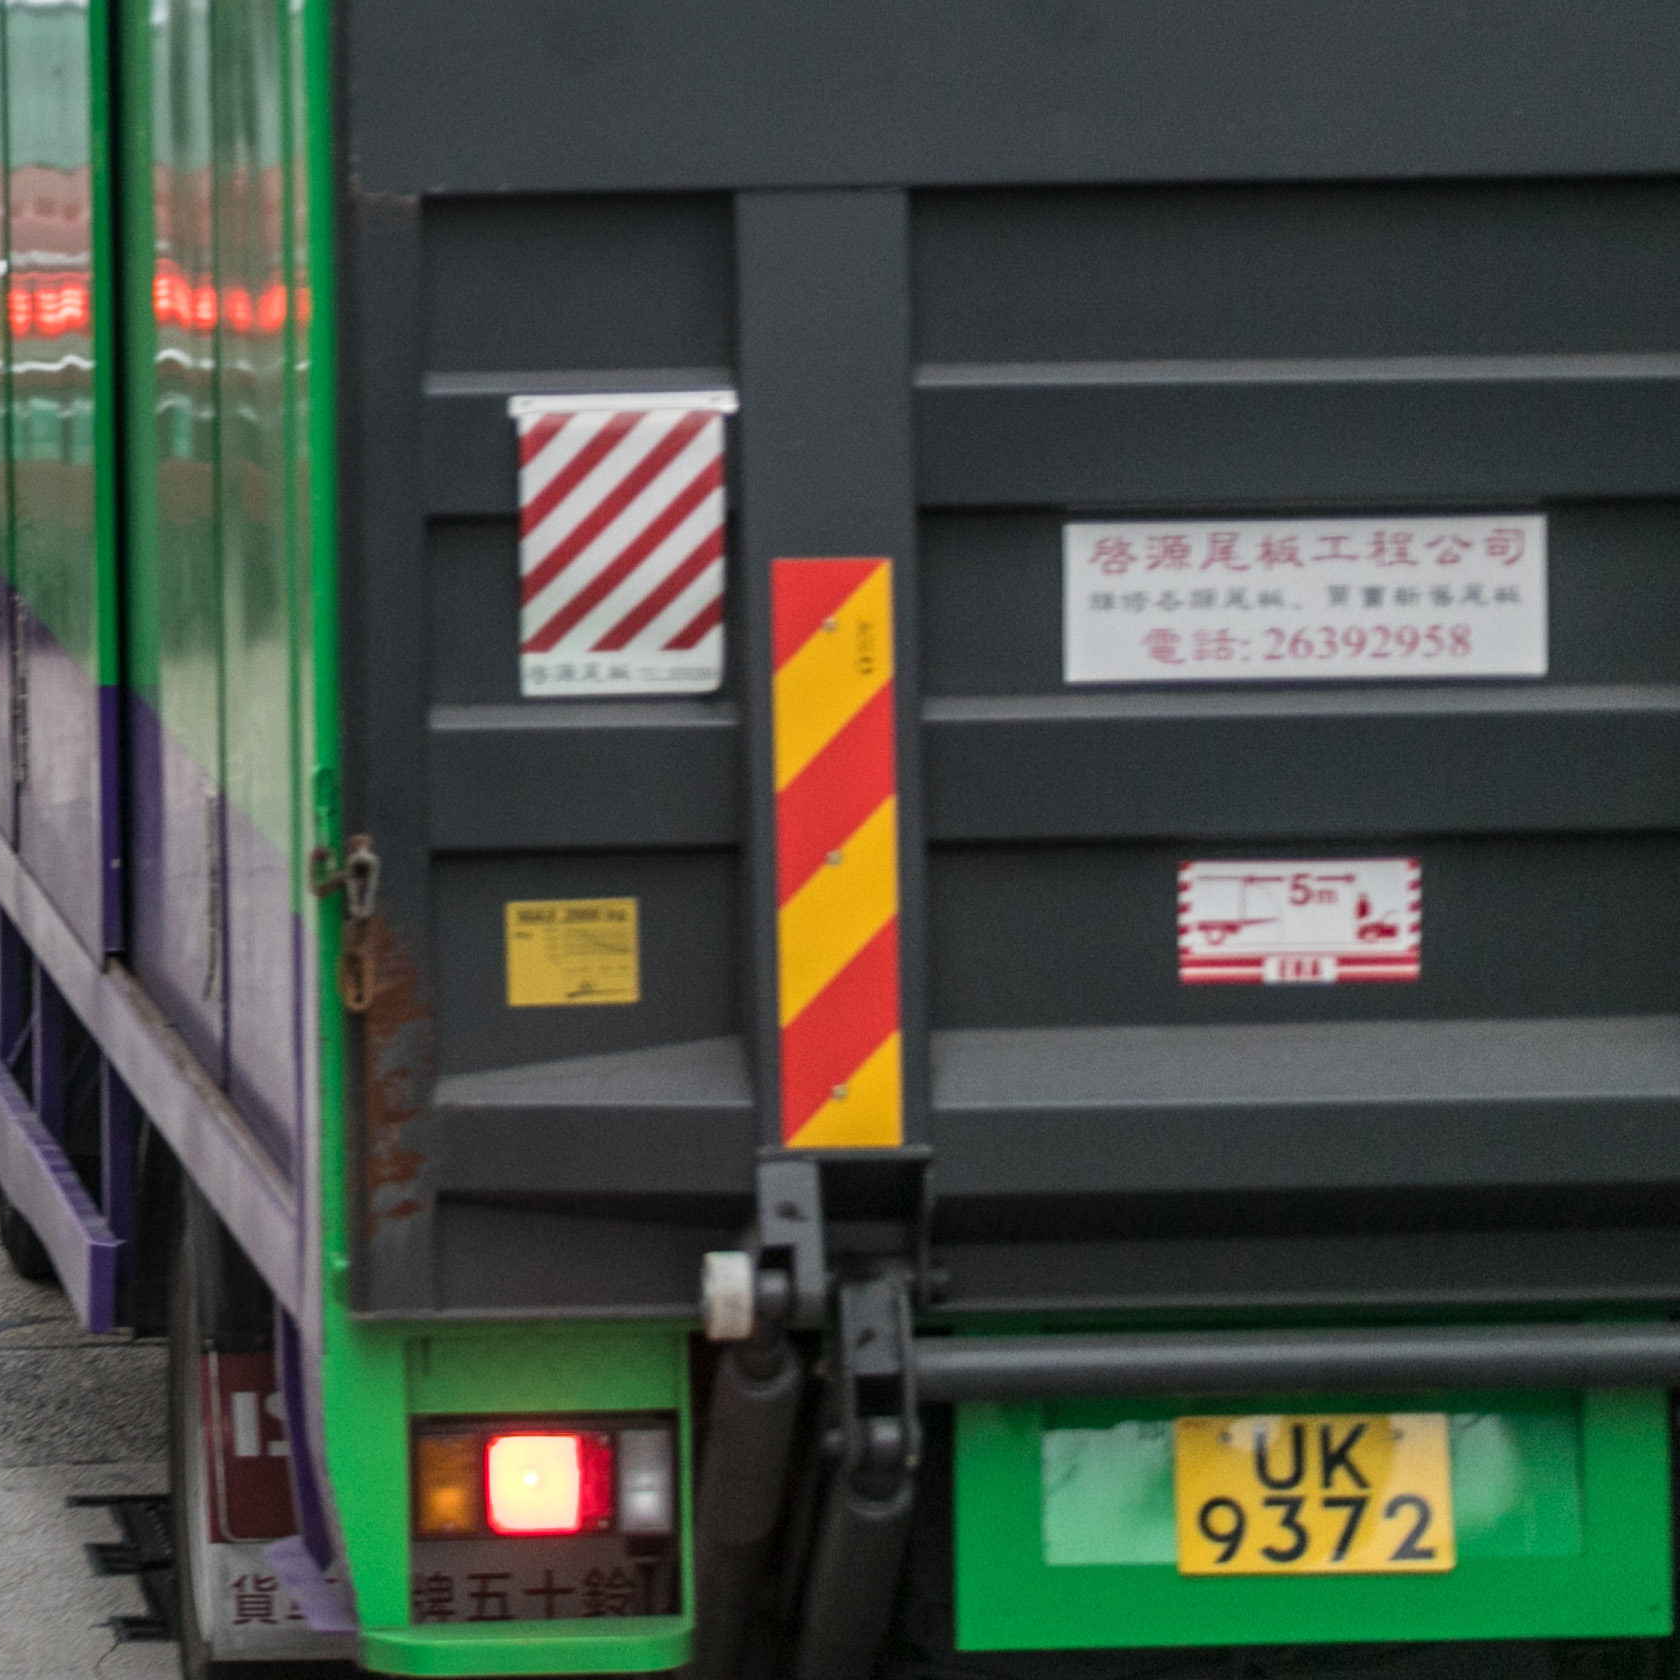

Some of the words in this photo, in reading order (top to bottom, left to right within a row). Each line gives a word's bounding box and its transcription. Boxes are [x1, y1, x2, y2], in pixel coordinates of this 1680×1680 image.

[1263, 622, 1474, 662] 26392958
[1251, 1423, 1372, 1491] UK
[1196, 1493, 1438, 1564] 9372
